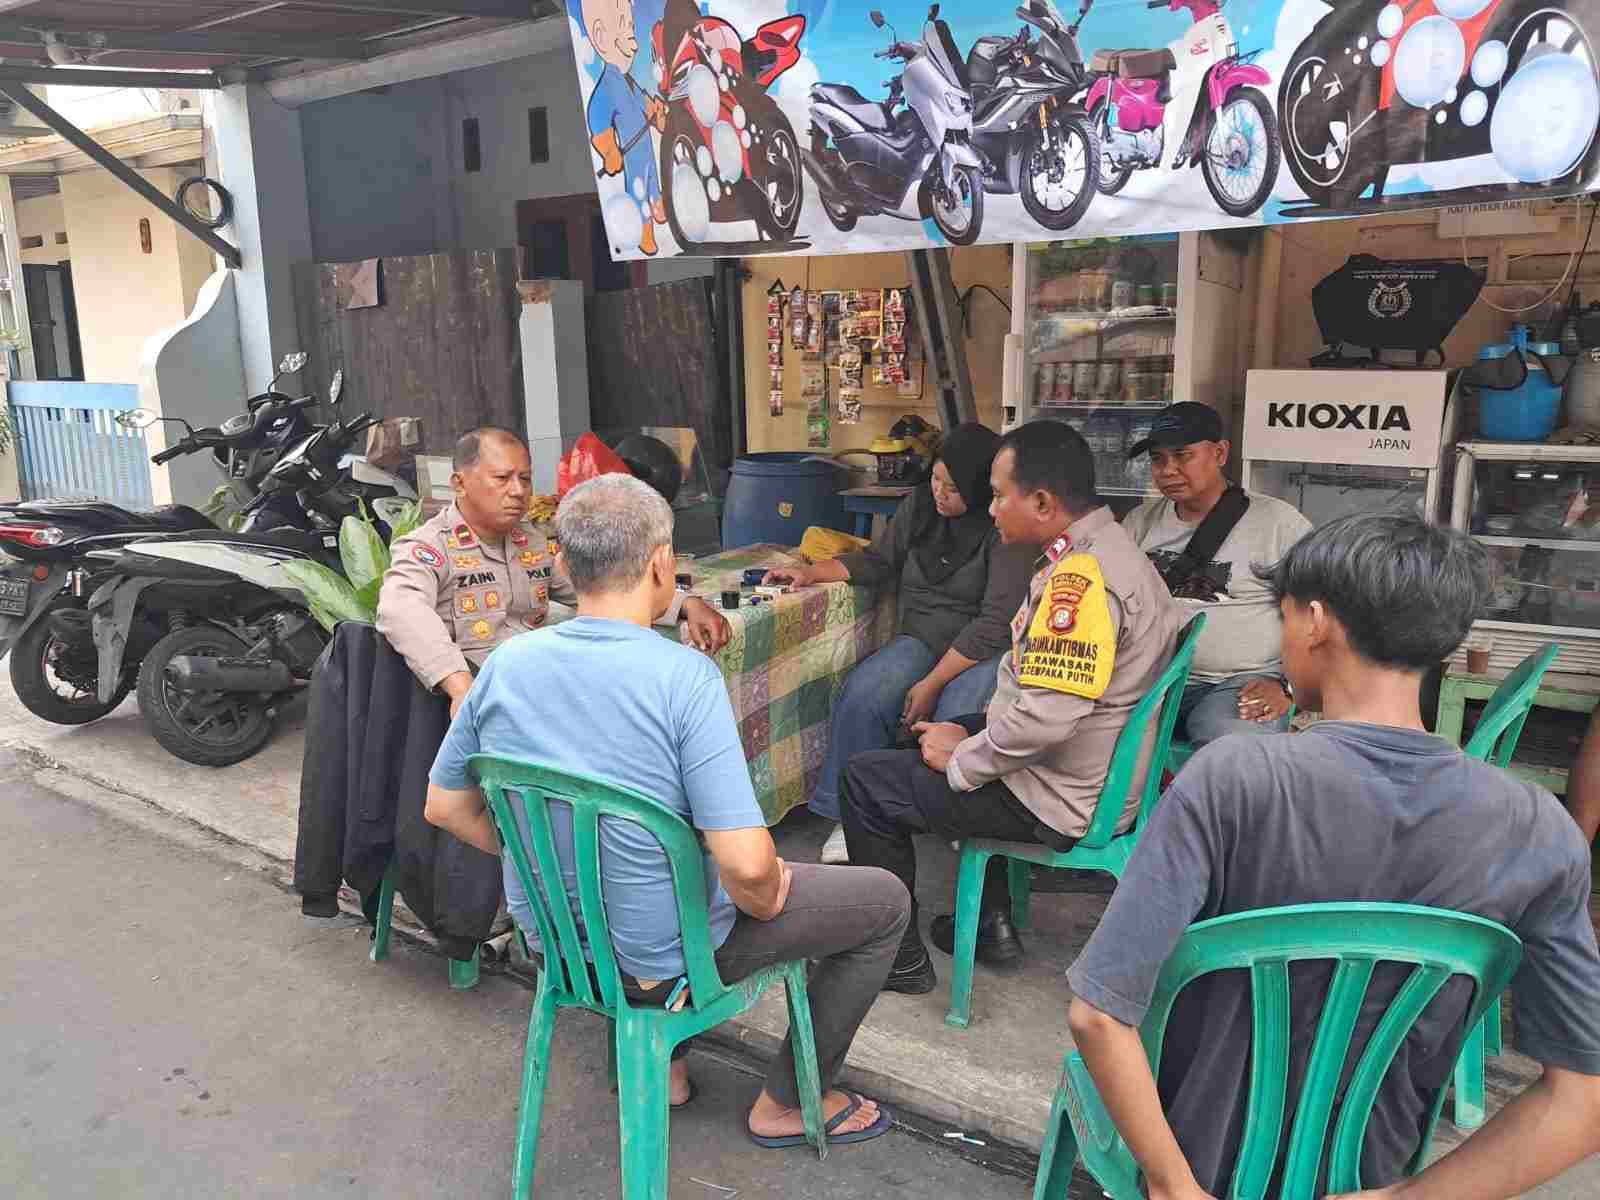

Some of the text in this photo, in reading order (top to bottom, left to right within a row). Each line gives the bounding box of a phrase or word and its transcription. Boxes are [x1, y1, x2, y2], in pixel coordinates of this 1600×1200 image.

[1268, 403, 1411, 431] KIOXIA
[1368, 439, 1411, 450] JAPAN
[457, 572, 496, 588] ZAINI
[1034, 656, 1096, 673] RAWASARI
[1067, 672, 1095, 686] PUTIH
